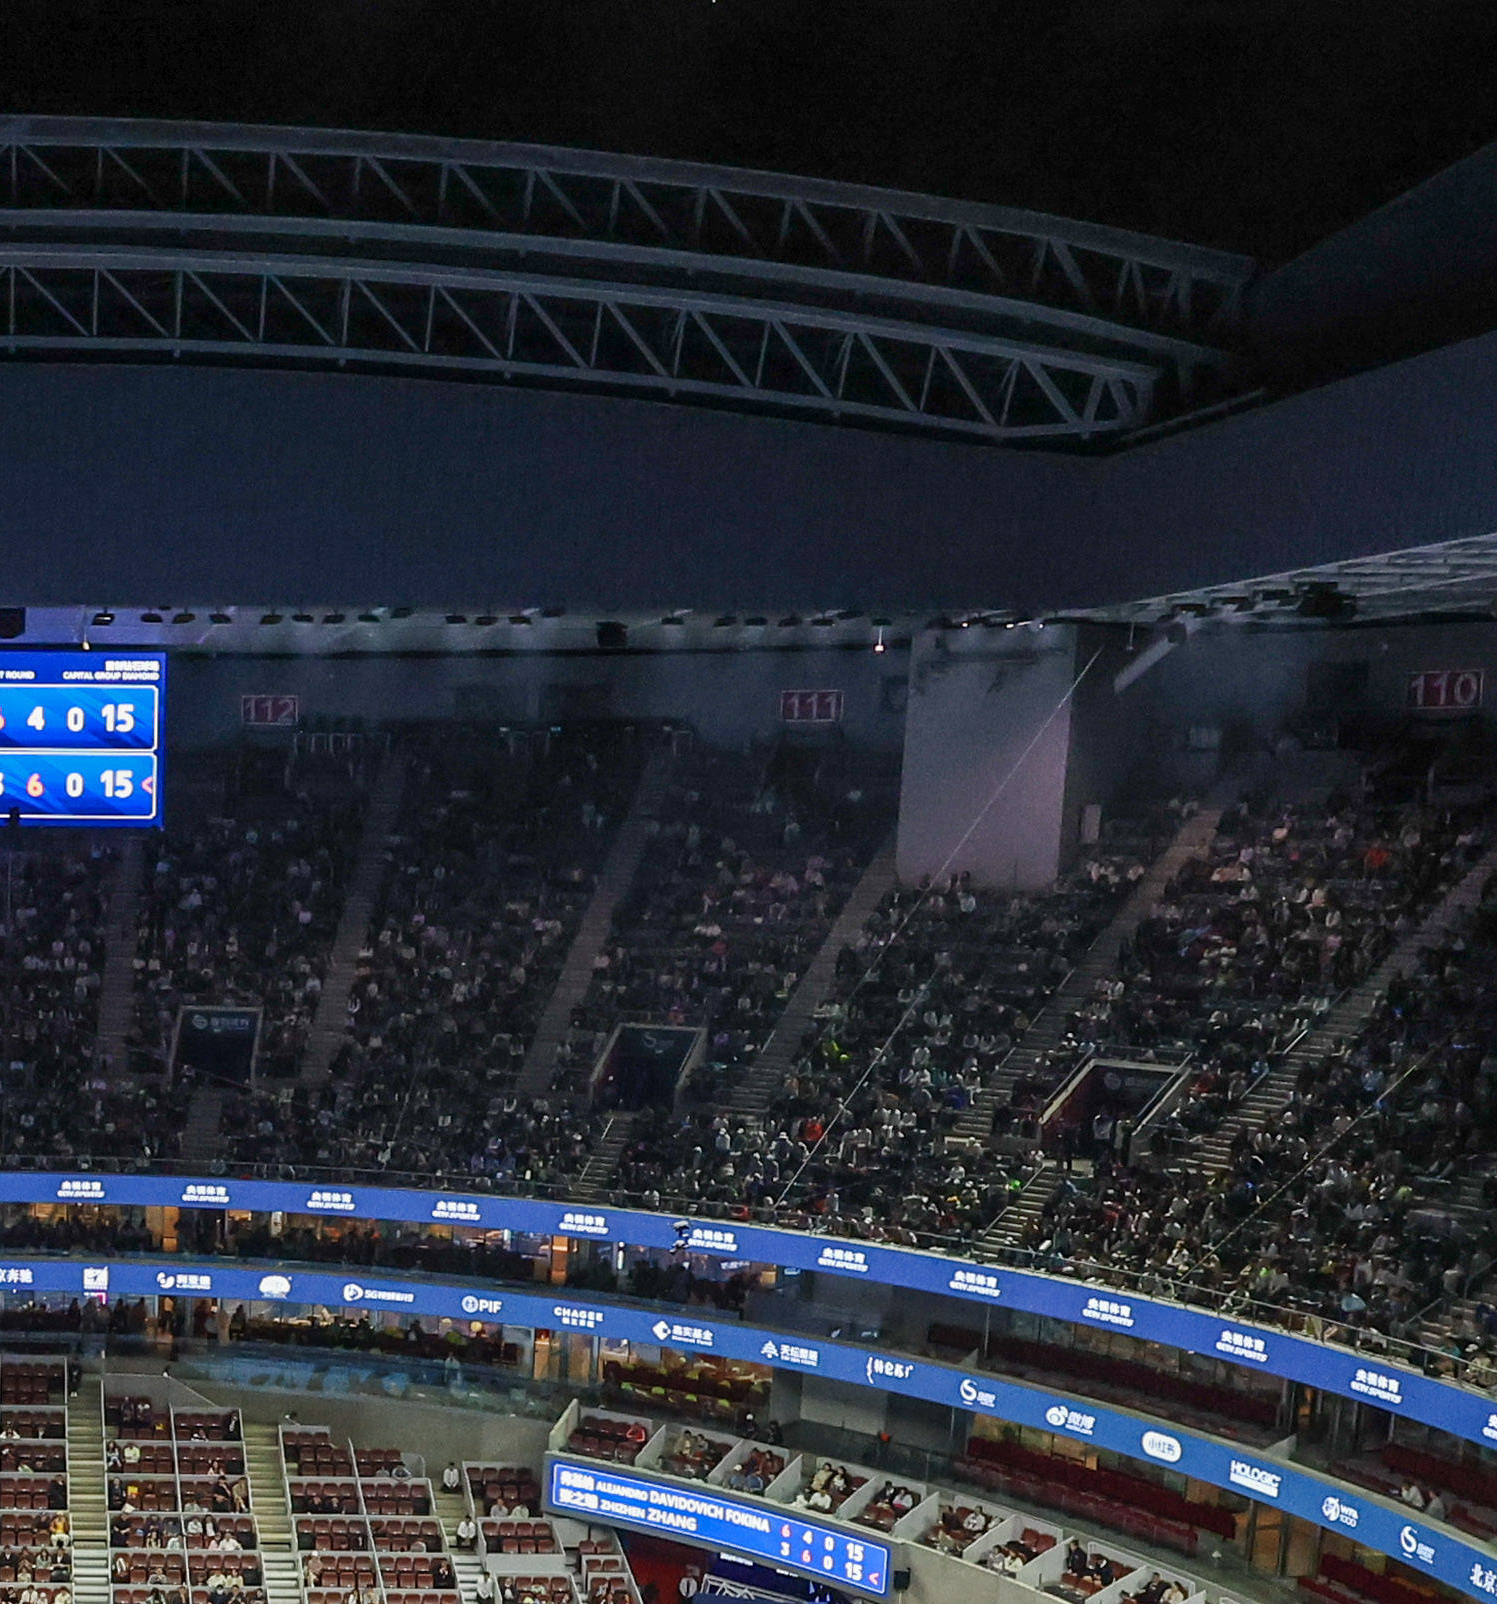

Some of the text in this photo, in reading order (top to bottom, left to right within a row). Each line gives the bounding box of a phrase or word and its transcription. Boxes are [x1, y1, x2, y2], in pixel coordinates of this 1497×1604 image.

[63, 671, 159, 681] CAPITAL GROUP DIAMOND
[1411, 673, 1478, 707] 110
[27, 706, 45, 730] 4
[67, 707, 84, 732] 0
[101, 704, 135, 732] 15
[244, 698, 296, 722] 112
[786, 693, 840, 720] 111
[26, 773, 44, 798] 6
[66, 773, 84, 798] 0
[100, 770, 134, 798] 15
[477, 1300, 501, 1313] PIF
[554, 1307, 604, 1321] CHAGEE
[1231, 1460, 1281, 1485] HOLOGIC
[596, 1480, 649, 1502] ALEJANDRO
[649, 1490, 724, 1520] DAVIDOVICH
[725, 1508, 771, 1533] FOKINA
[781, 1523, 791, 1538] 6
[802, 1530, 813, 1545] 4
[824, 1536, 834, 1551] 0
[846, 1543, 864, 1562] 15
[1341, 1506, 1358, 1518] WTA
[1341, 1515, 1357, 1529] 1000
[600, 1499, 862, 1581] ZHIZHEN ZHANG 3 6 0 15
